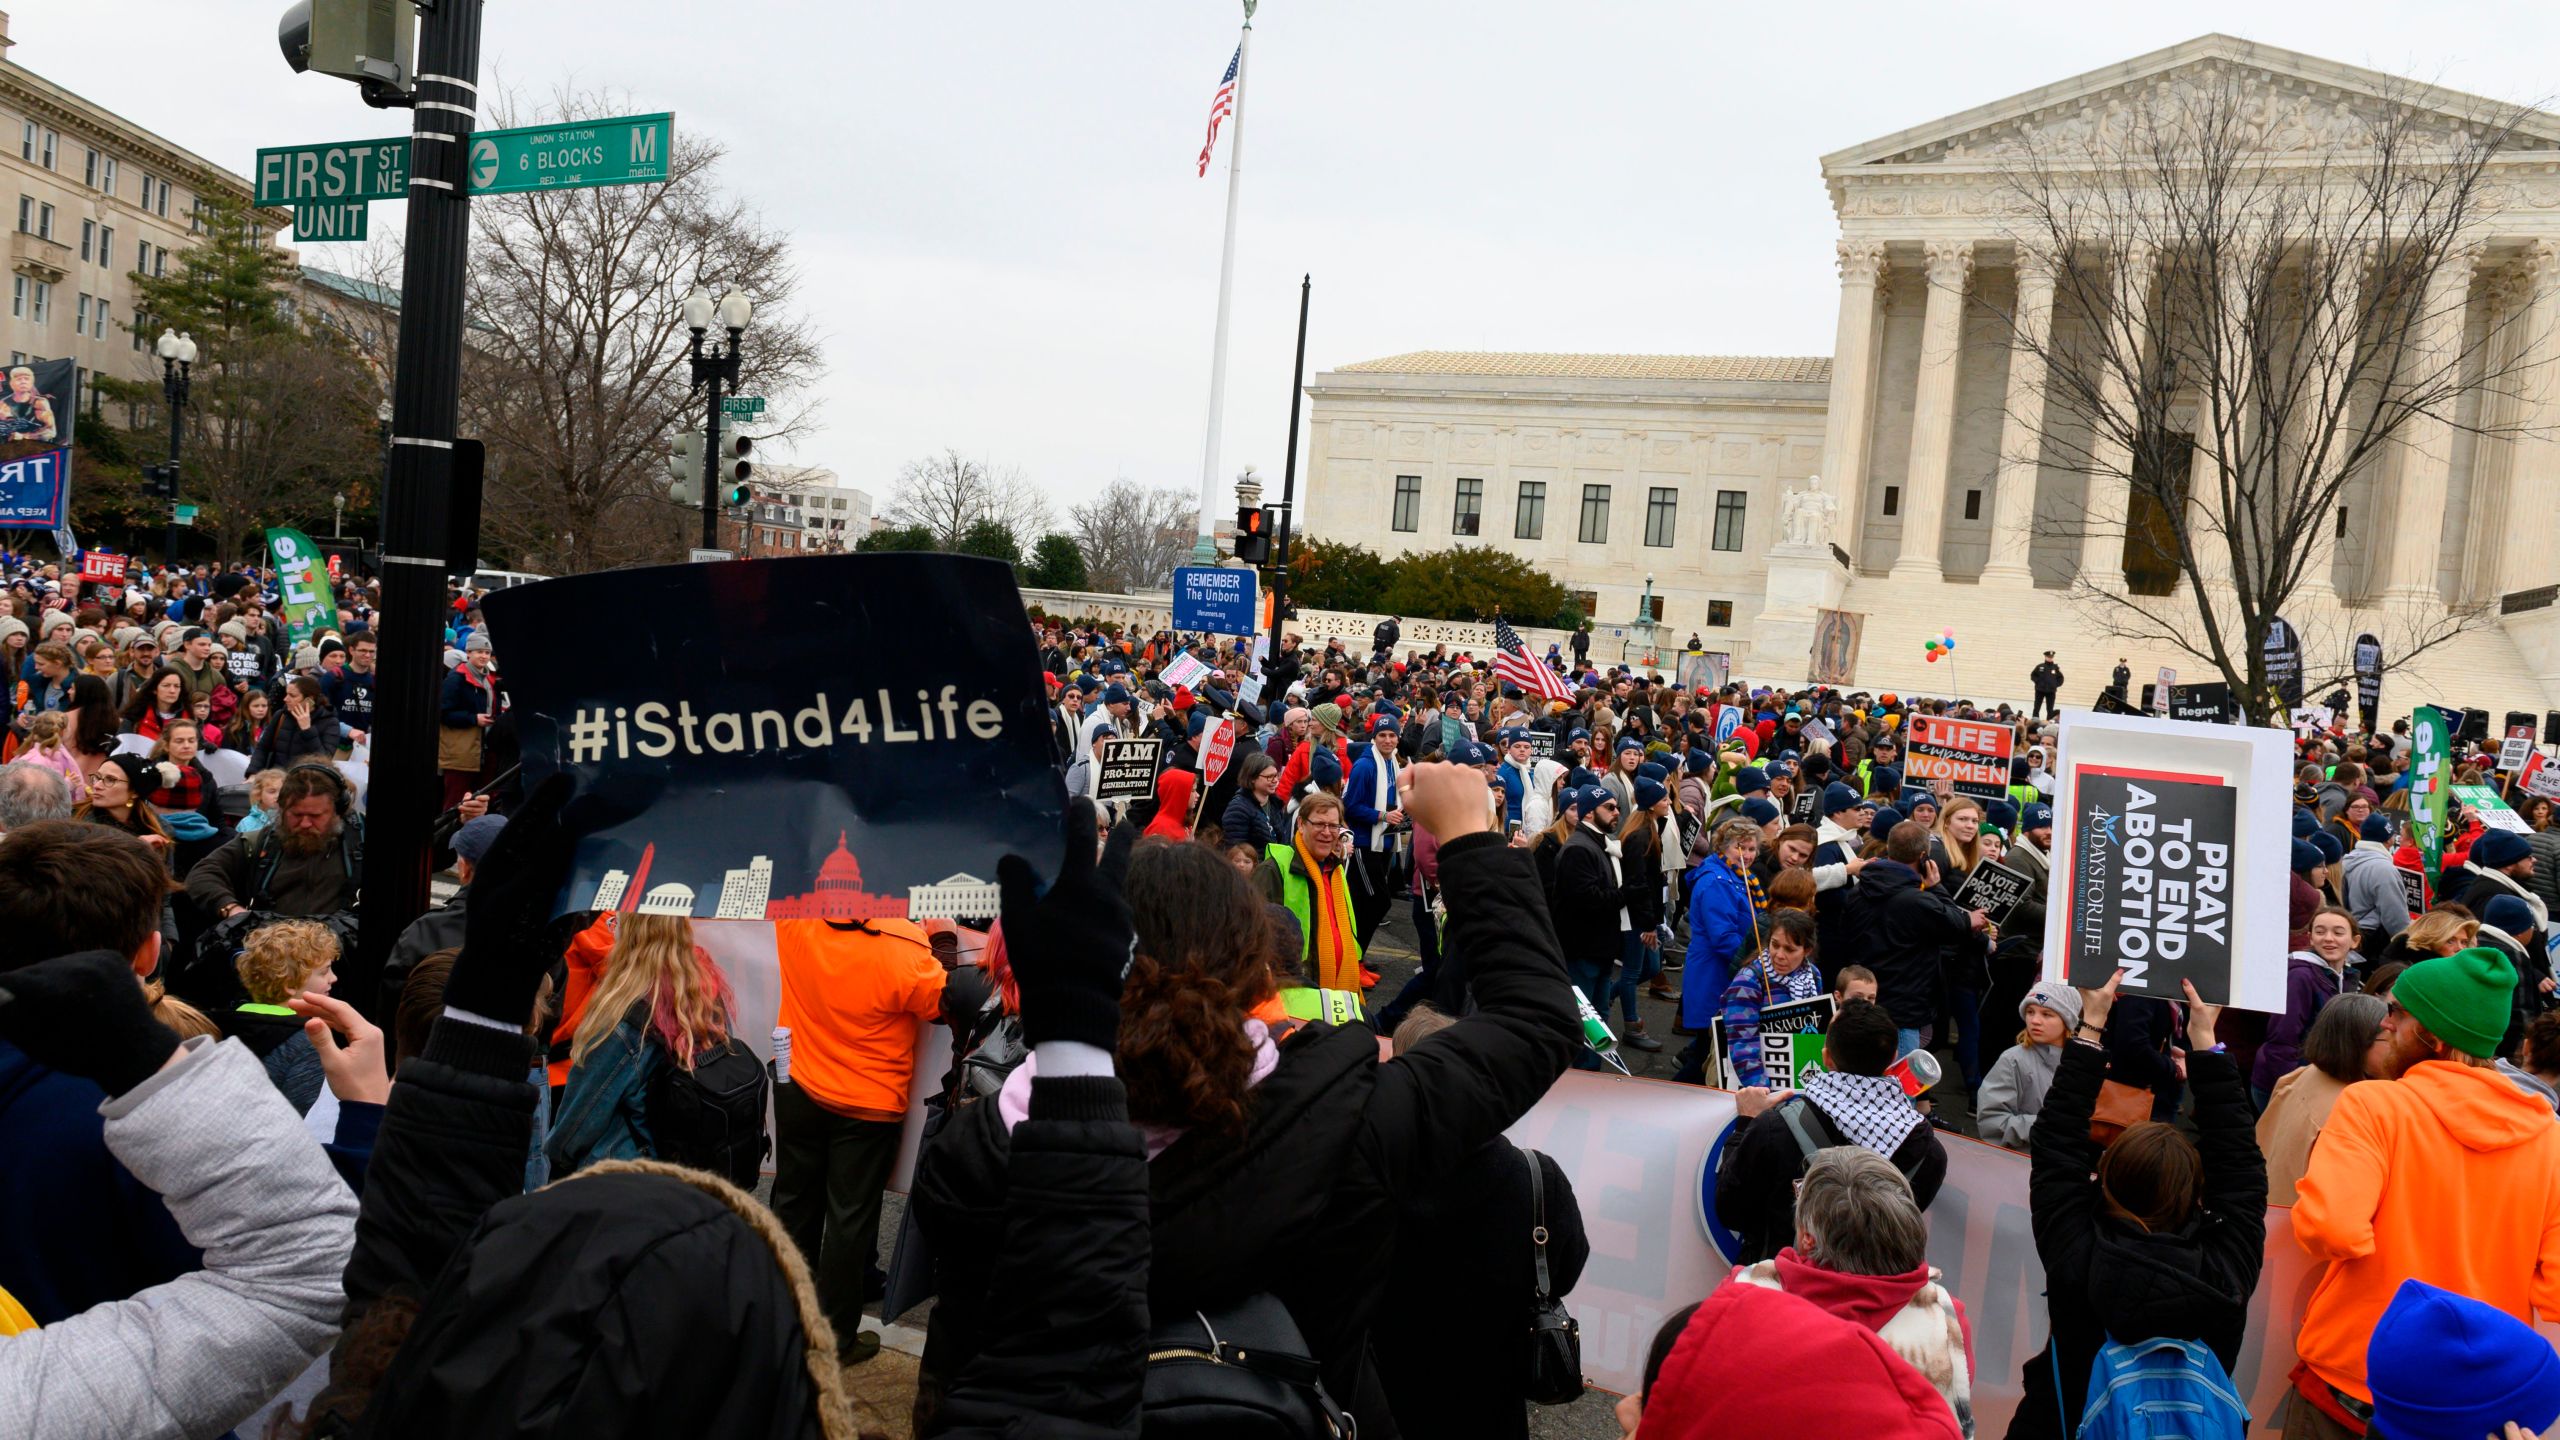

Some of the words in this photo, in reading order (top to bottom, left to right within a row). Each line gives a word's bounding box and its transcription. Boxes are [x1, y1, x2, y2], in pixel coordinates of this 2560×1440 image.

[530, 134, 554, 145] UNION
[559, 130, 595, 143] STATION
[630, 126, 656, 163] M
[519, 153, 529, 171] 6
[538, 146, 604, 169] BLOCKS
[261, 147, 372, 200] FIRST
[378, 145, 402, 169] ST
[377, 170, 403, 193] NE
[539, 175, 556, 186] RED
[564, 174, 582, 184] LINE
[629, 167, 656, 178] metro
[297, 204, 363, 238] UNIT
[723, 399, 754, 411] FIRST
[733, 412, 752, 421] UNIT
[86, 559, 124, 578] LIFE
[274, 536, 316, 604] Life
[1186, 573, 1240, 589] REMEMBER
[1186, 588, 1202, 600] The
[1206, 589, 1240, 603] Unborn
[227, 660, 241, 668] TO
[243, 661, 259, 670] END
[231, 652, 257, 661] PRAY
[2196, 694, 2200, 703] I
[2178, 705, 2220, 717] Regret
[1217, 727, 1233, 741] STOP
[1927, 723, 1998, 752] LIFE
[1106, 744, 1116, 762] I
[1117, 743, 1155, 761] AM
[1209, 742, 1233, 757] ABORTION
[1920, 743, 1998, 768] empowers
[1103, 768, 1151, 779] PRO-LIFE
[1207, 758, 1225, 772] NOW
[1907, 758, 2006, 784] WOMEN
[2410, 721, 2441, 823] Life
[1102, 780, 1149, 789] GENERATION
[2536, 773, 2560, 787] SAVE
[2159, 818, 2192, 870] TO
[1981, 870, 1989, 879] I
[1990, 872, 2019, 893] VOTE
[2117, 782, 2157, 988] ABORTION
[1967, 877, 2018, 907] PRO-LIFE
[2193, 841, 2228, 946] PRAY
[1969, 893, 2000, 913] FIRST
[2155, 879, 2190, 960] END
[1334, 1000, 1345, 1023] POL
[1764, 1036, 1791, 1089] DEFE
